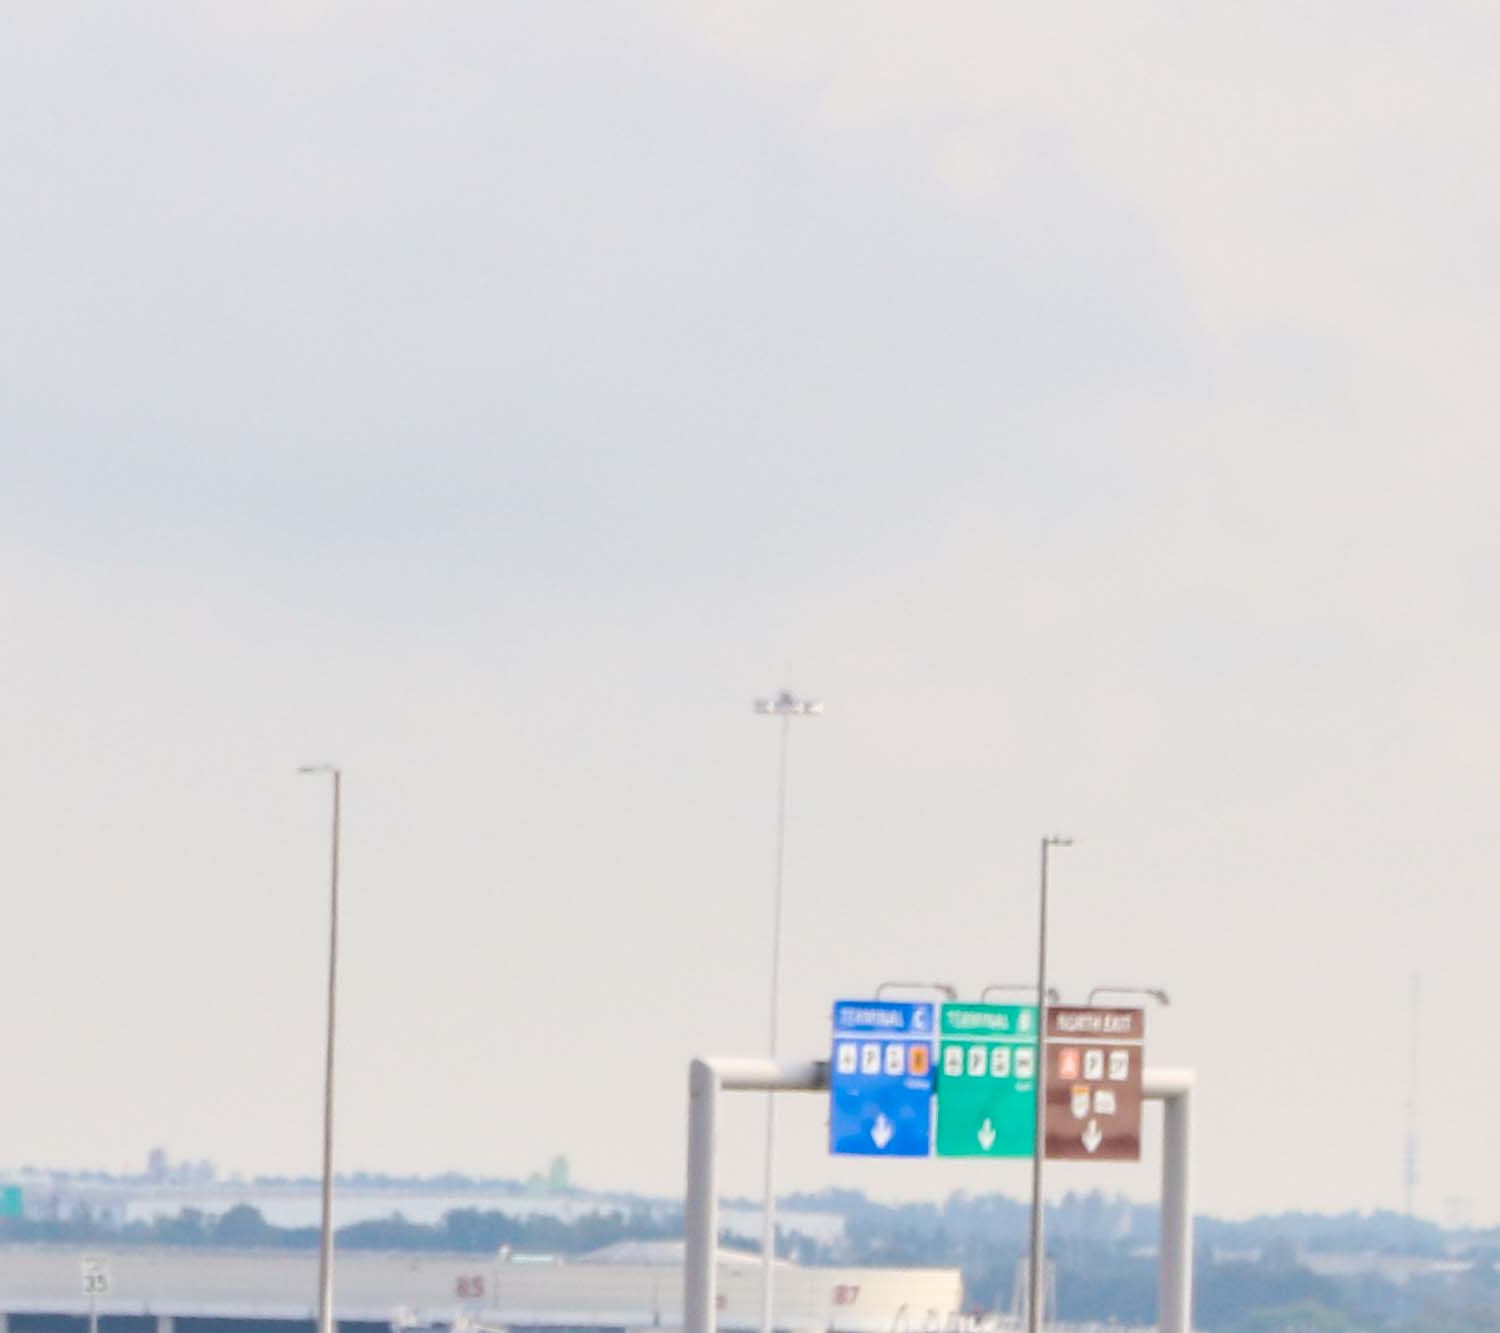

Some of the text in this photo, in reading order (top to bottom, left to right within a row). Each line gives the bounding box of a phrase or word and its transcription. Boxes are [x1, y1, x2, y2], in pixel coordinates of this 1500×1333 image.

[840, 1006, 928, 1031] TERMINAL C
[947, 1010, 1009, 1030] TERMINAL
[1057, 1013, 1130, 1032] NORTH EXIT
